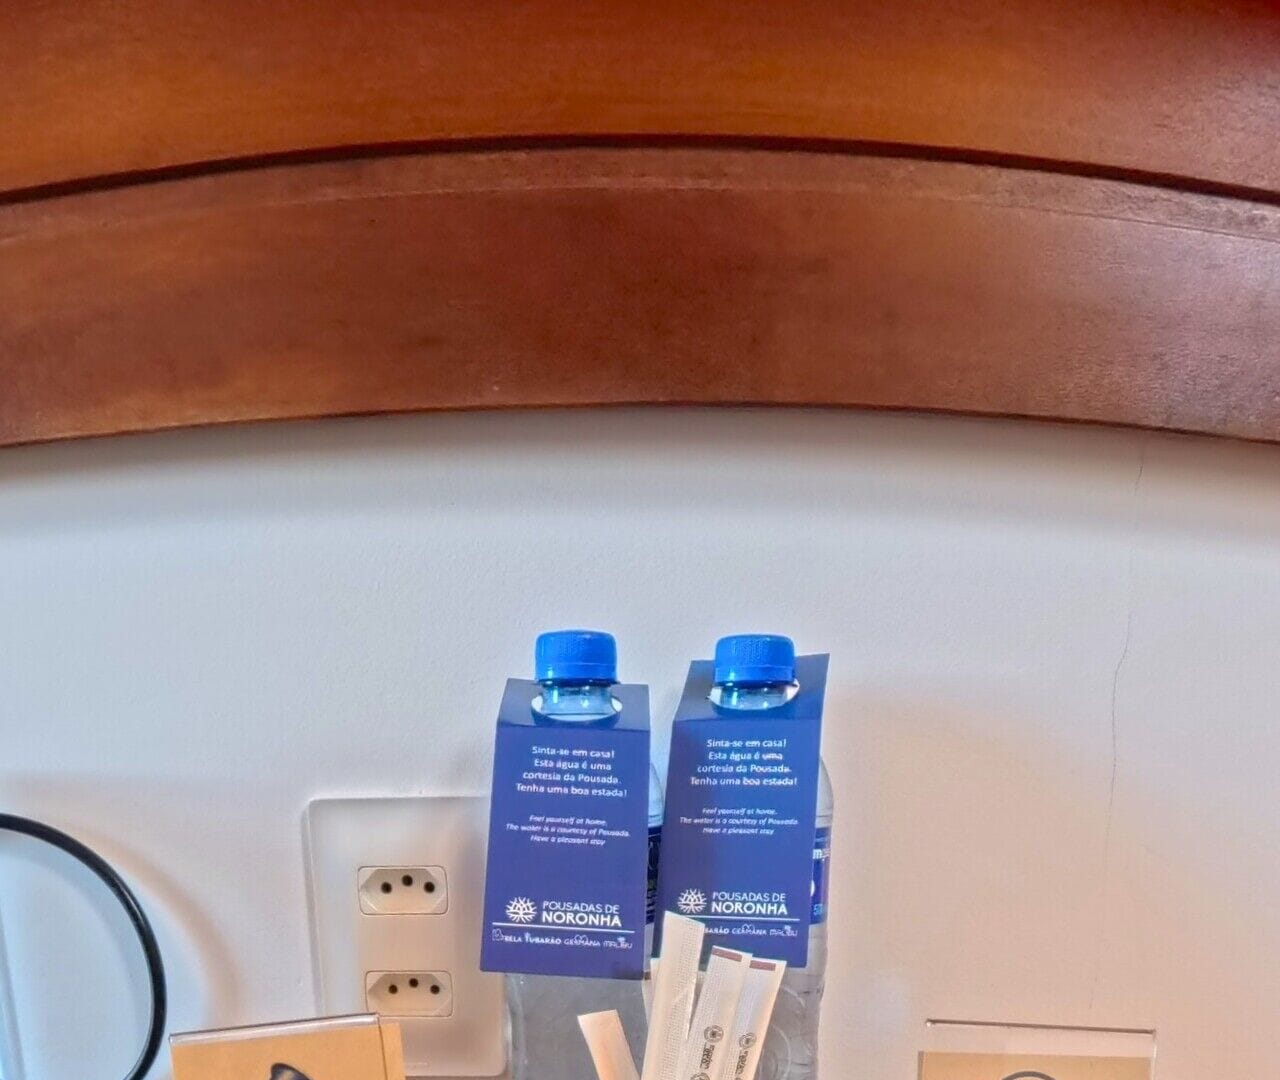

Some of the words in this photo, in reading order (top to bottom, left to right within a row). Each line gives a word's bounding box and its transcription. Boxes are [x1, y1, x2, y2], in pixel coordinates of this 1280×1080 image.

[707, 739, 743, 748] Sinta-se
[762, 738, 787, 748] casa!
[532, 746, 570, 756] Sinta-se
[590, 750, 615, 758] casa!
[709, 752, 727, 760] Esta
[730, 752, 753, 761] água
[534, 759, 554, 768] Esta
[697, 764, 734, 773] cortesia
[736, 764, 748, 772] da
[523, 772, 560, 780] cortesia
[564, 773, 576, 782] da
[690, 777, 718, 786] Tenha
[720, 778, 740, 786] uma
[742, 777, 760, 786] boa
[762, 778, 798, 786] estada!
[516, 783, 545, 793] Tenha
[547, 786, 568, 794] uma
[570, 786, 589, 795] boa
[592, 788, 628, 798] estada!
[712, 892, 770, 902] POUSADAS
[772, 892, 786, 902] DE
[542, 901, 602, 914] POUSADAS
[605, 904, 620, 914] DE
[711, 902, 788, 916] NORONHA
[542, 911, 622, 927] NORONHA
